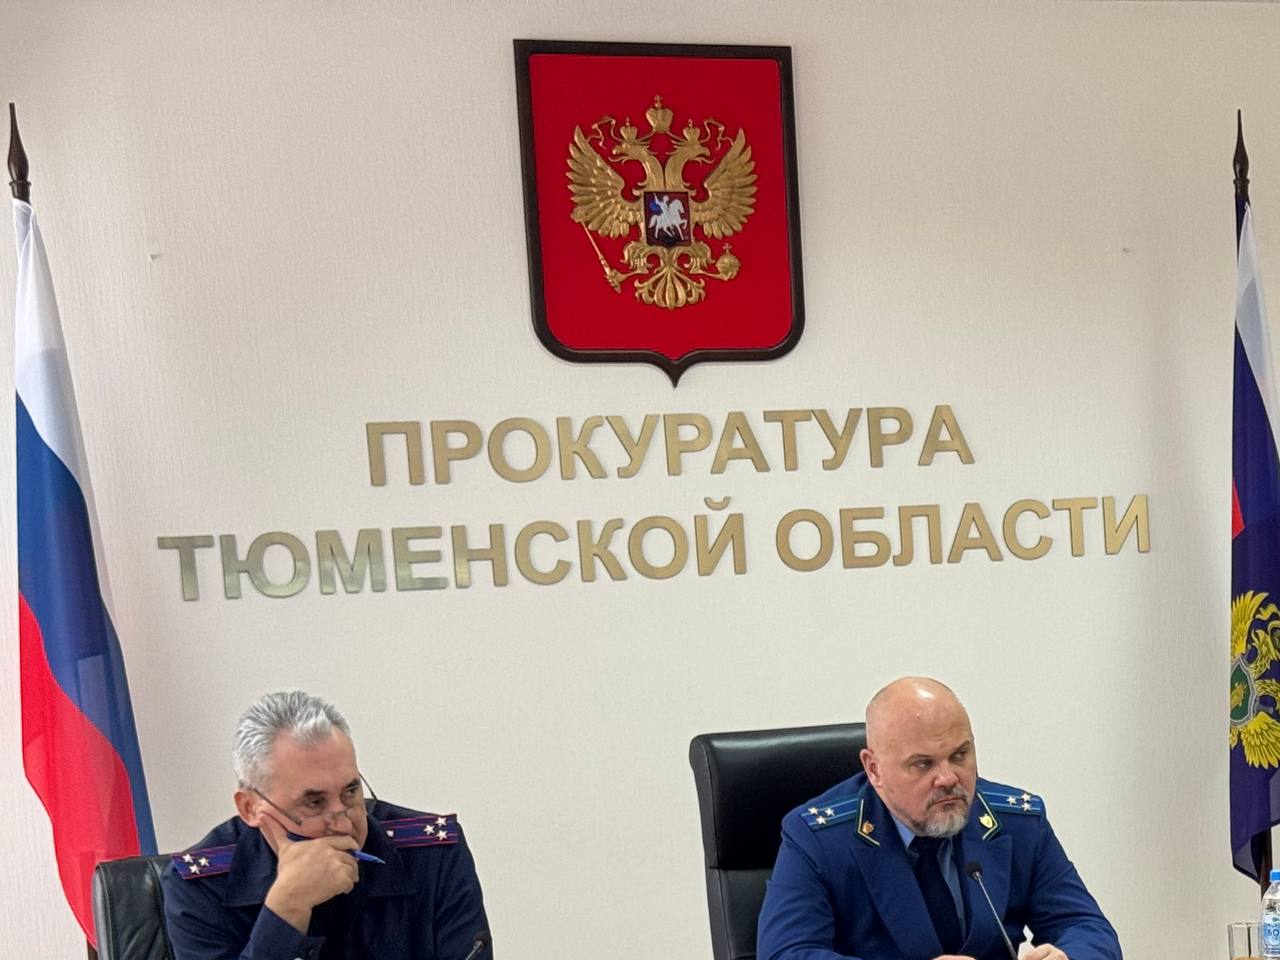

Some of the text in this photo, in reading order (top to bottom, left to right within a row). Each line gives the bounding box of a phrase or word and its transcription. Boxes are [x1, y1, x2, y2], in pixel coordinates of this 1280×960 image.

[364, 405, 975, 488] ПРОКУРАТУРА
[156, 494, 1152, 602] ТЮМЕНСКОЙ ОБЛАСТИ
